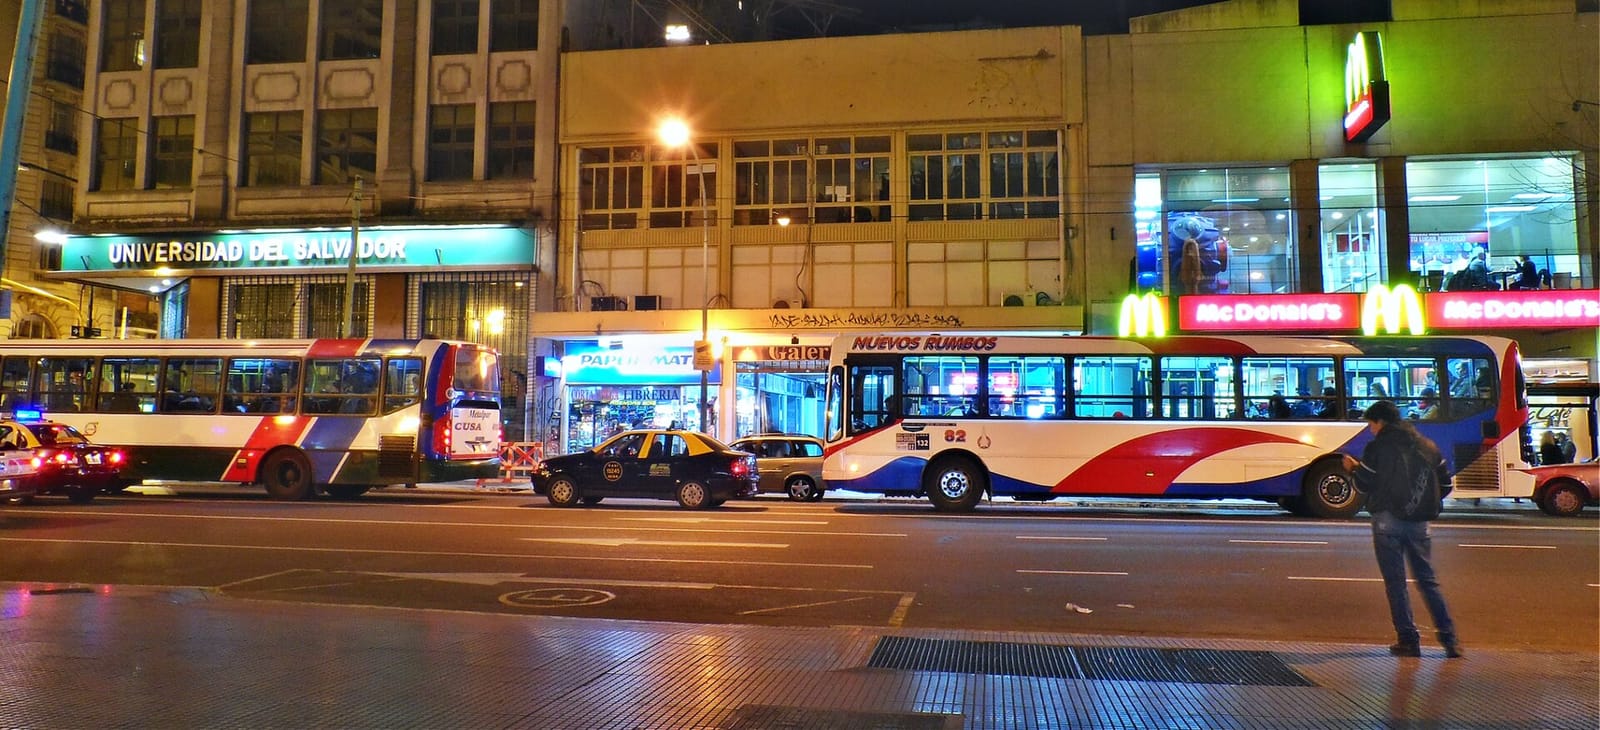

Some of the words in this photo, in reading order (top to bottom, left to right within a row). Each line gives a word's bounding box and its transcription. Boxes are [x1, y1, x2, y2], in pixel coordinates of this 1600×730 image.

[108, 240, 243, 264] UNIVERSIDAD
[249, 239, 290, 262] DEL
[294, 237, 407, 262] SALVADOR
[1196, 303, 1342, 321] McDonald's
[1444, 299, 1600, 318] McDonald's
[852, 336, 921, 350] NUEVOS
[923, 337, 998, 350] RUMBOS
[455, 422, 482, 431] CUSA
[944, 429, 966, 442] 82
